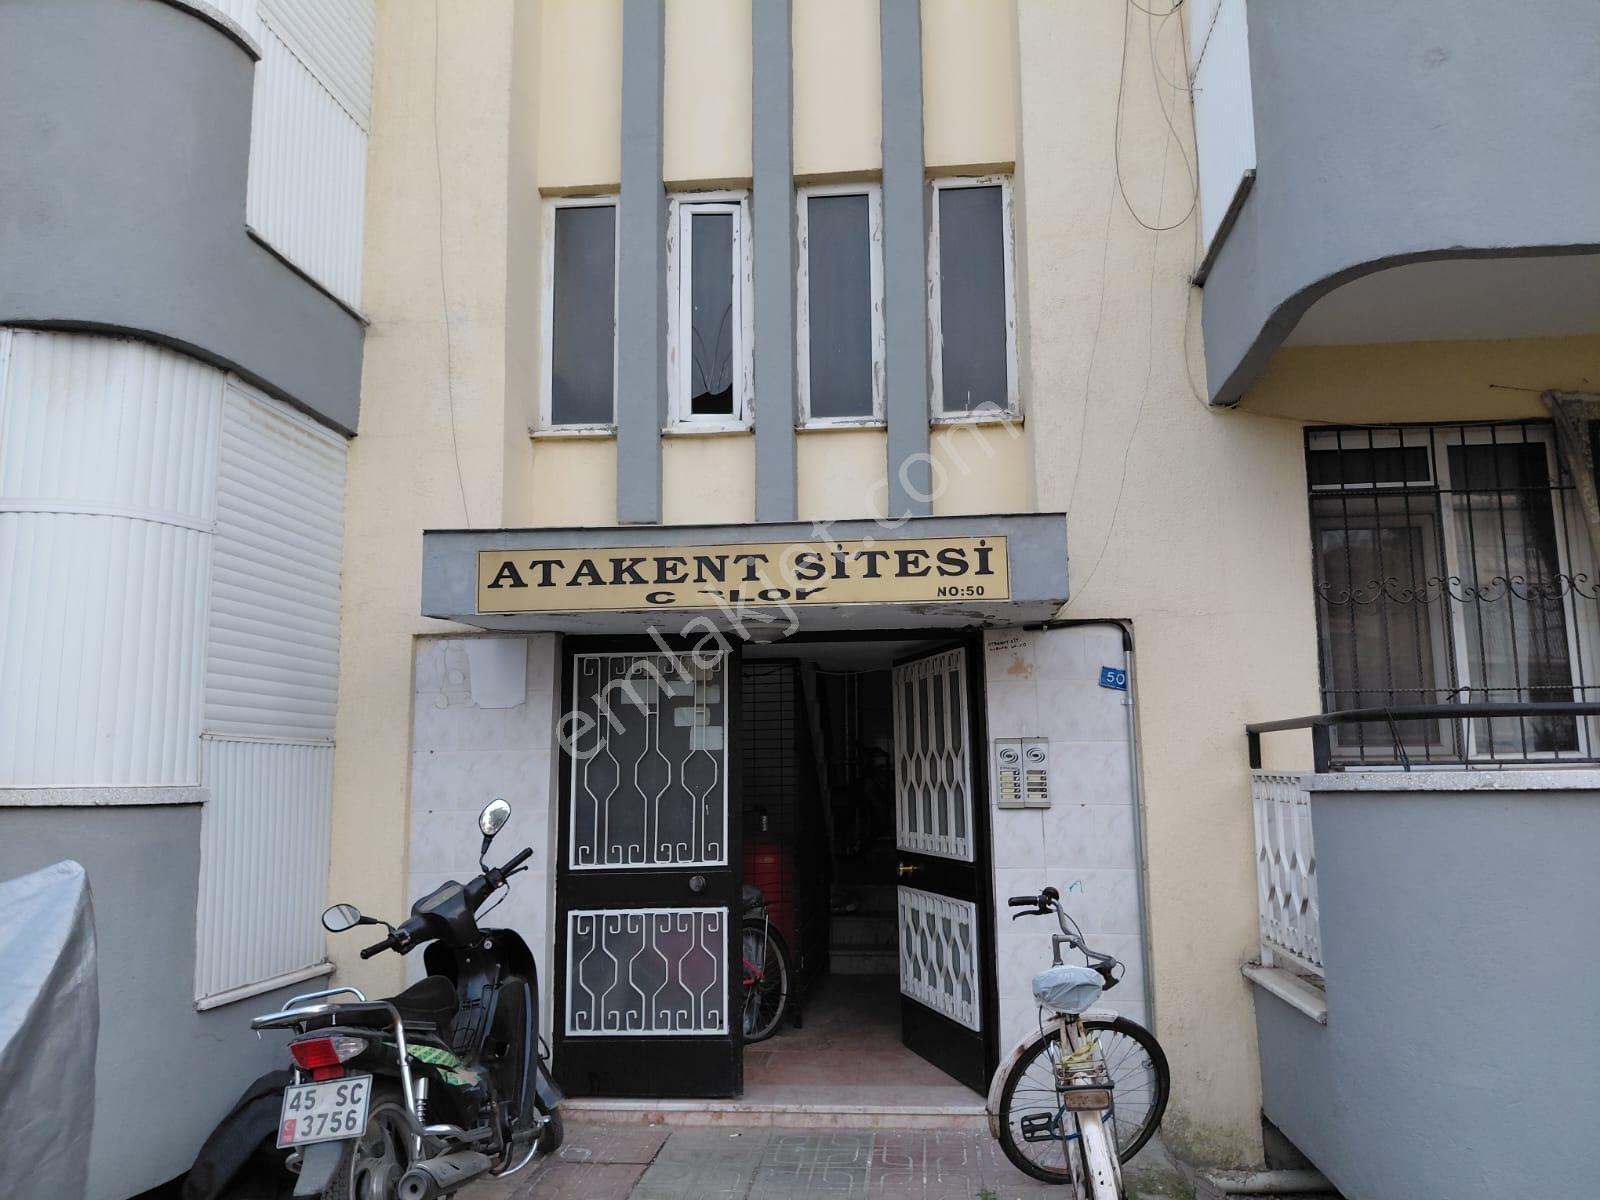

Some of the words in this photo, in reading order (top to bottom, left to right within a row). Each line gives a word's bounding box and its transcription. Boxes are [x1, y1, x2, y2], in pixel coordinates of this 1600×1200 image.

[487, 554, 769, 588] ATAKENT
[792, 539, 994, 580] SİTESİ
[645, 591, 676, 604] C
[937, 586, 984, 597] NO:50
[1106, 671, 1125, 685] 50
[289, 1090, 317, 1112] 45
[335, 1083, 363, 1107] SC
[301, 1109, 357, 1137] 3756
